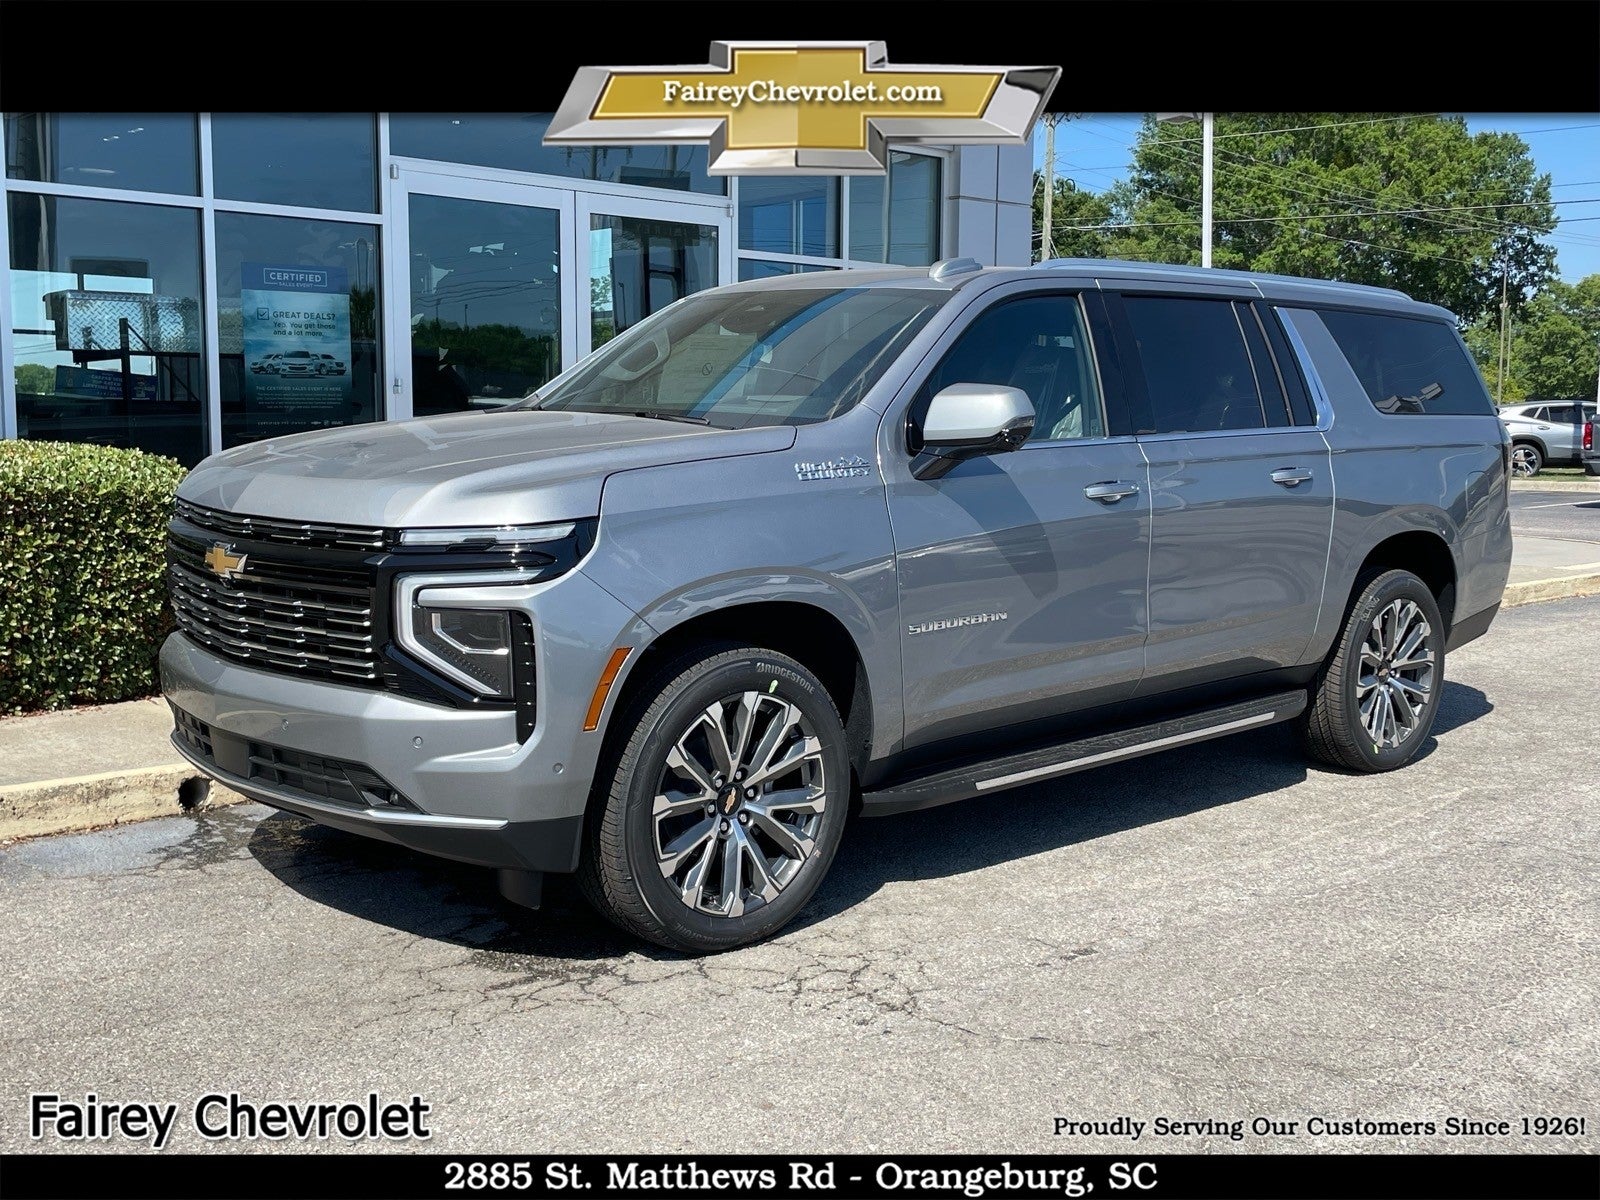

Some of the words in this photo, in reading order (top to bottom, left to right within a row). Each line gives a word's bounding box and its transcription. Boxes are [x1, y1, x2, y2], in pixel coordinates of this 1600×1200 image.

[269, 272, 322, 283] CERTIFIED
[272, 310, 302, 319] GREAT
[303, 312, 336, 321] DEALS?
[908, 611, 1008, 635] SUBURBAN
[756, 662, 816, 695] BRIDGESTONE
